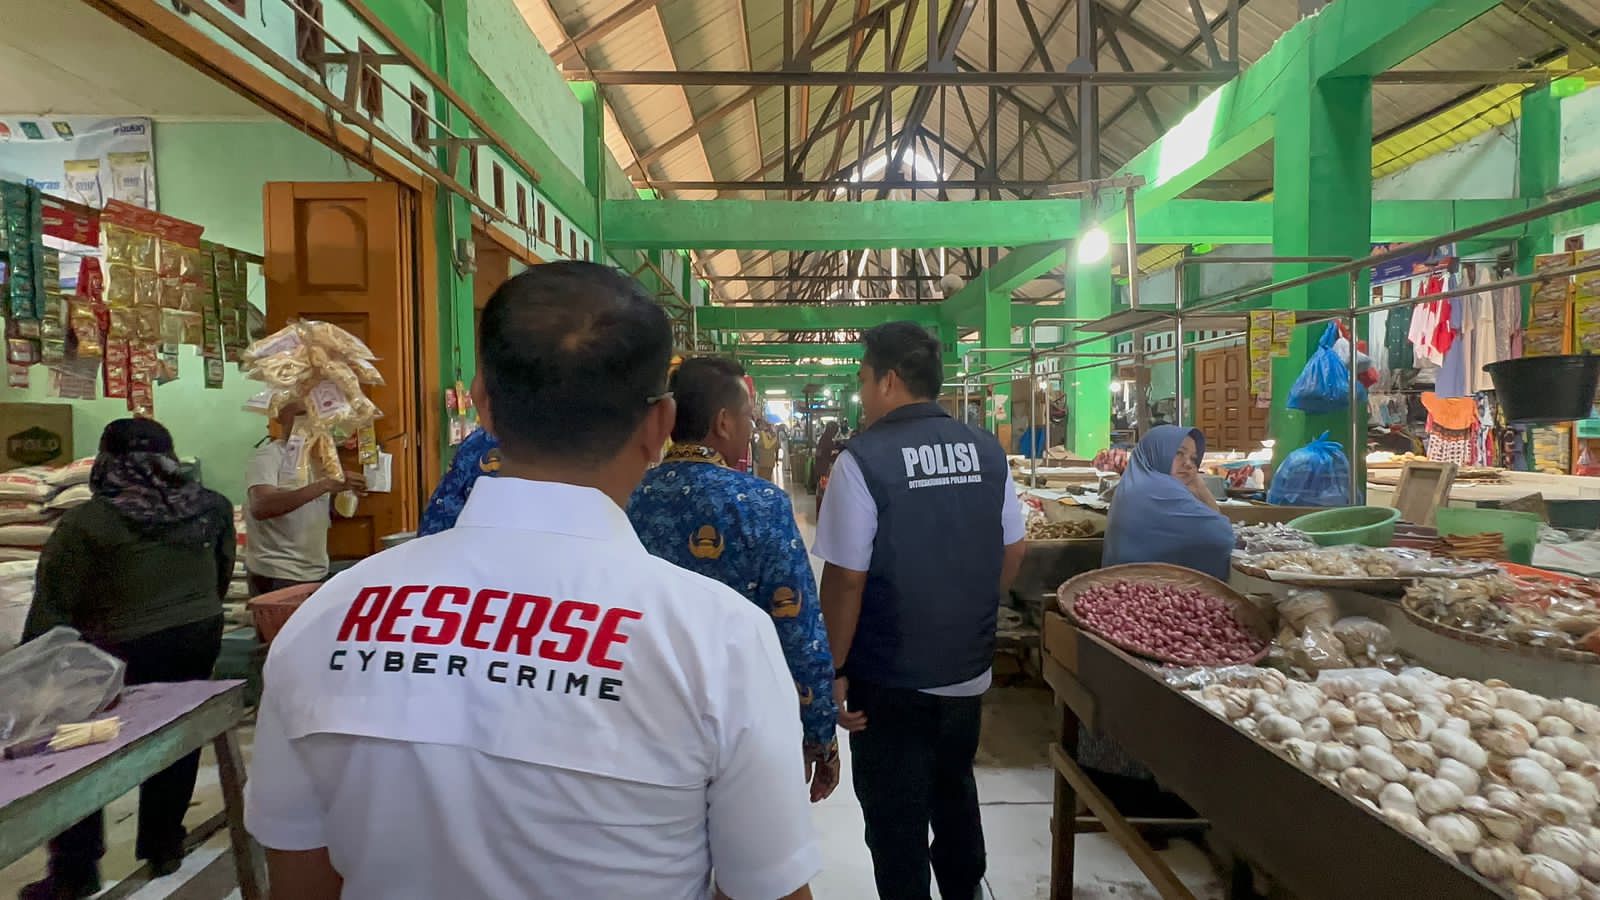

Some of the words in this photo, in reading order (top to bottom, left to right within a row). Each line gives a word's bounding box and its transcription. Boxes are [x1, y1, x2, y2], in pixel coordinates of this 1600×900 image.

[902, 442, 980, 477] POLISI
[336, 584, 644, 671] RESERSE
[329, 650, 468, 677] CYBER
[487, 660, 624, 701] CRIME
